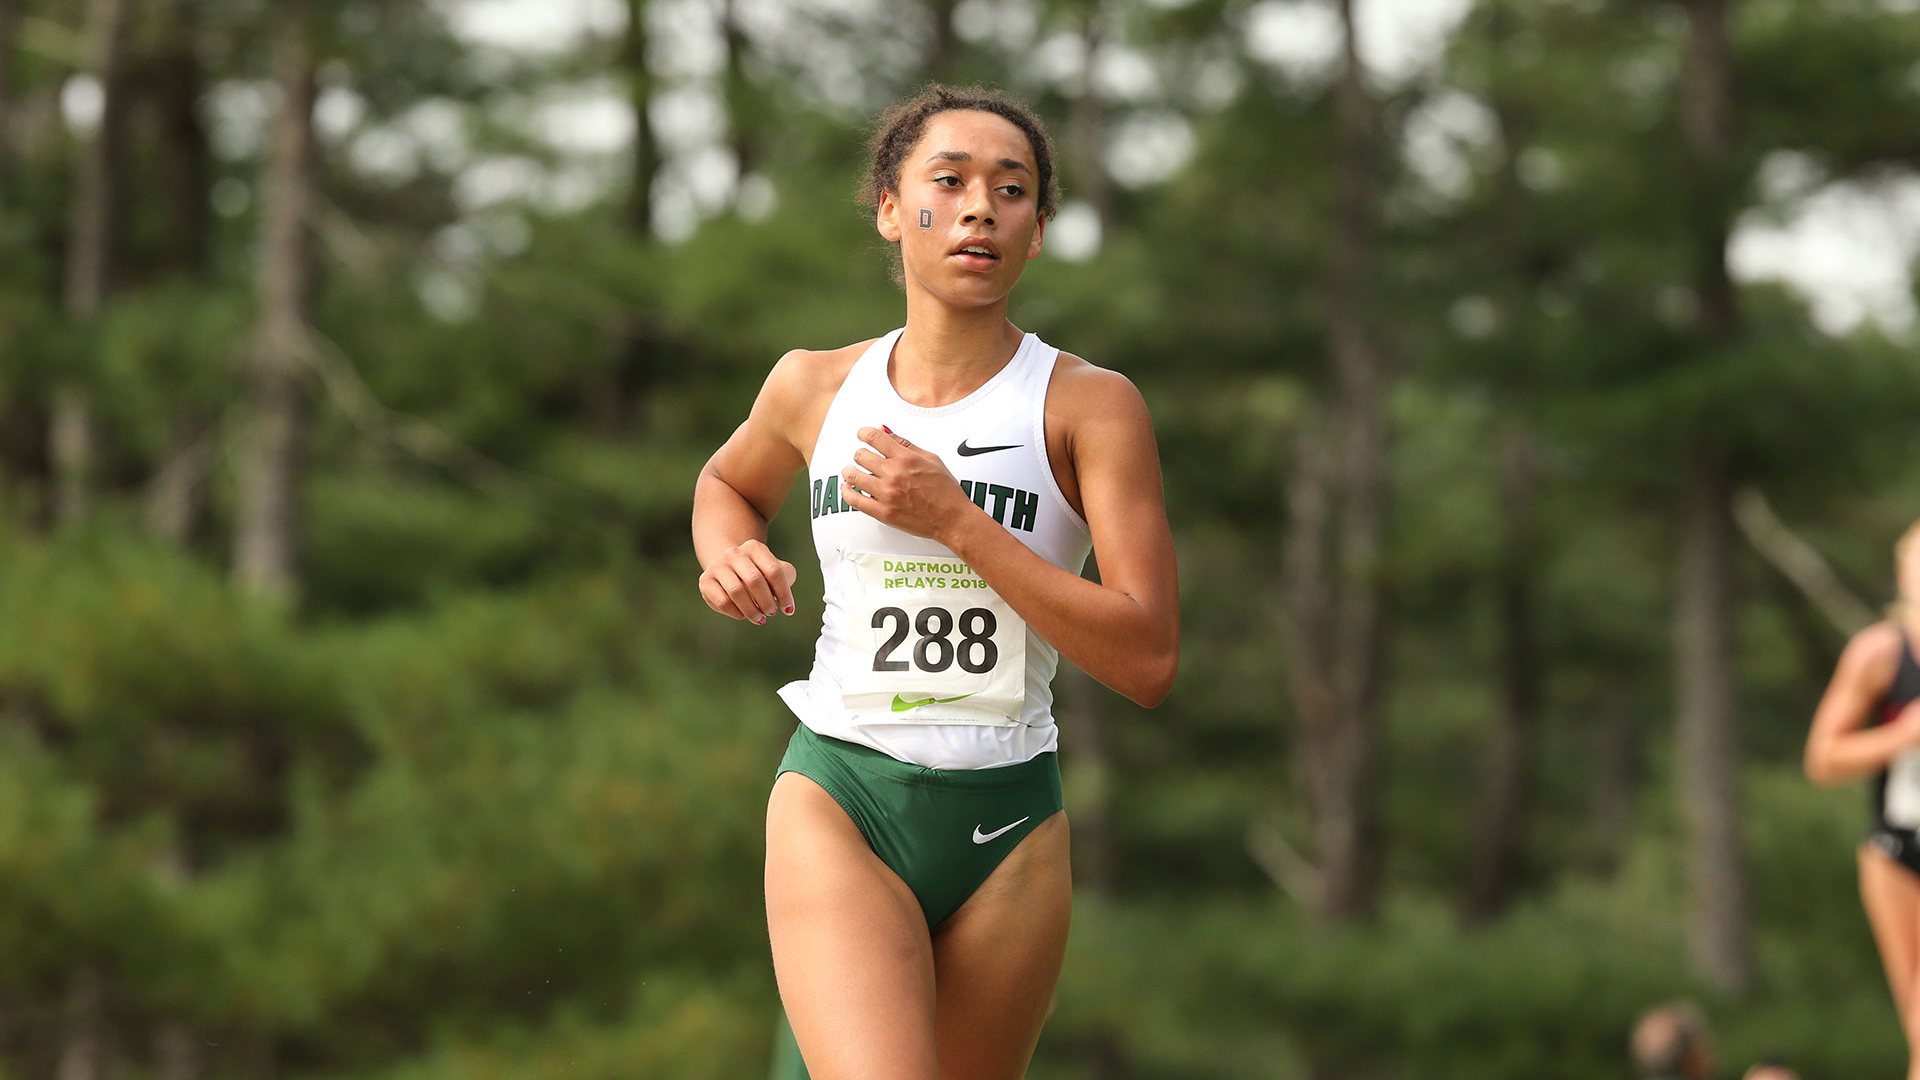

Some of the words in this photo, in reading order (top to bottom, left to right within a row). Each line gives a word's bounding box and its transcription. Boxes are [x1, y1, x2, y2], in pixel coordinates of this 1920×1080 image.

[883, 560, 972, 575] DARTMOUT
[884, 576, 946, 589] RELAYS
[950, 578, 988, 589] 2018
[871, 606, 998, 674] 288
